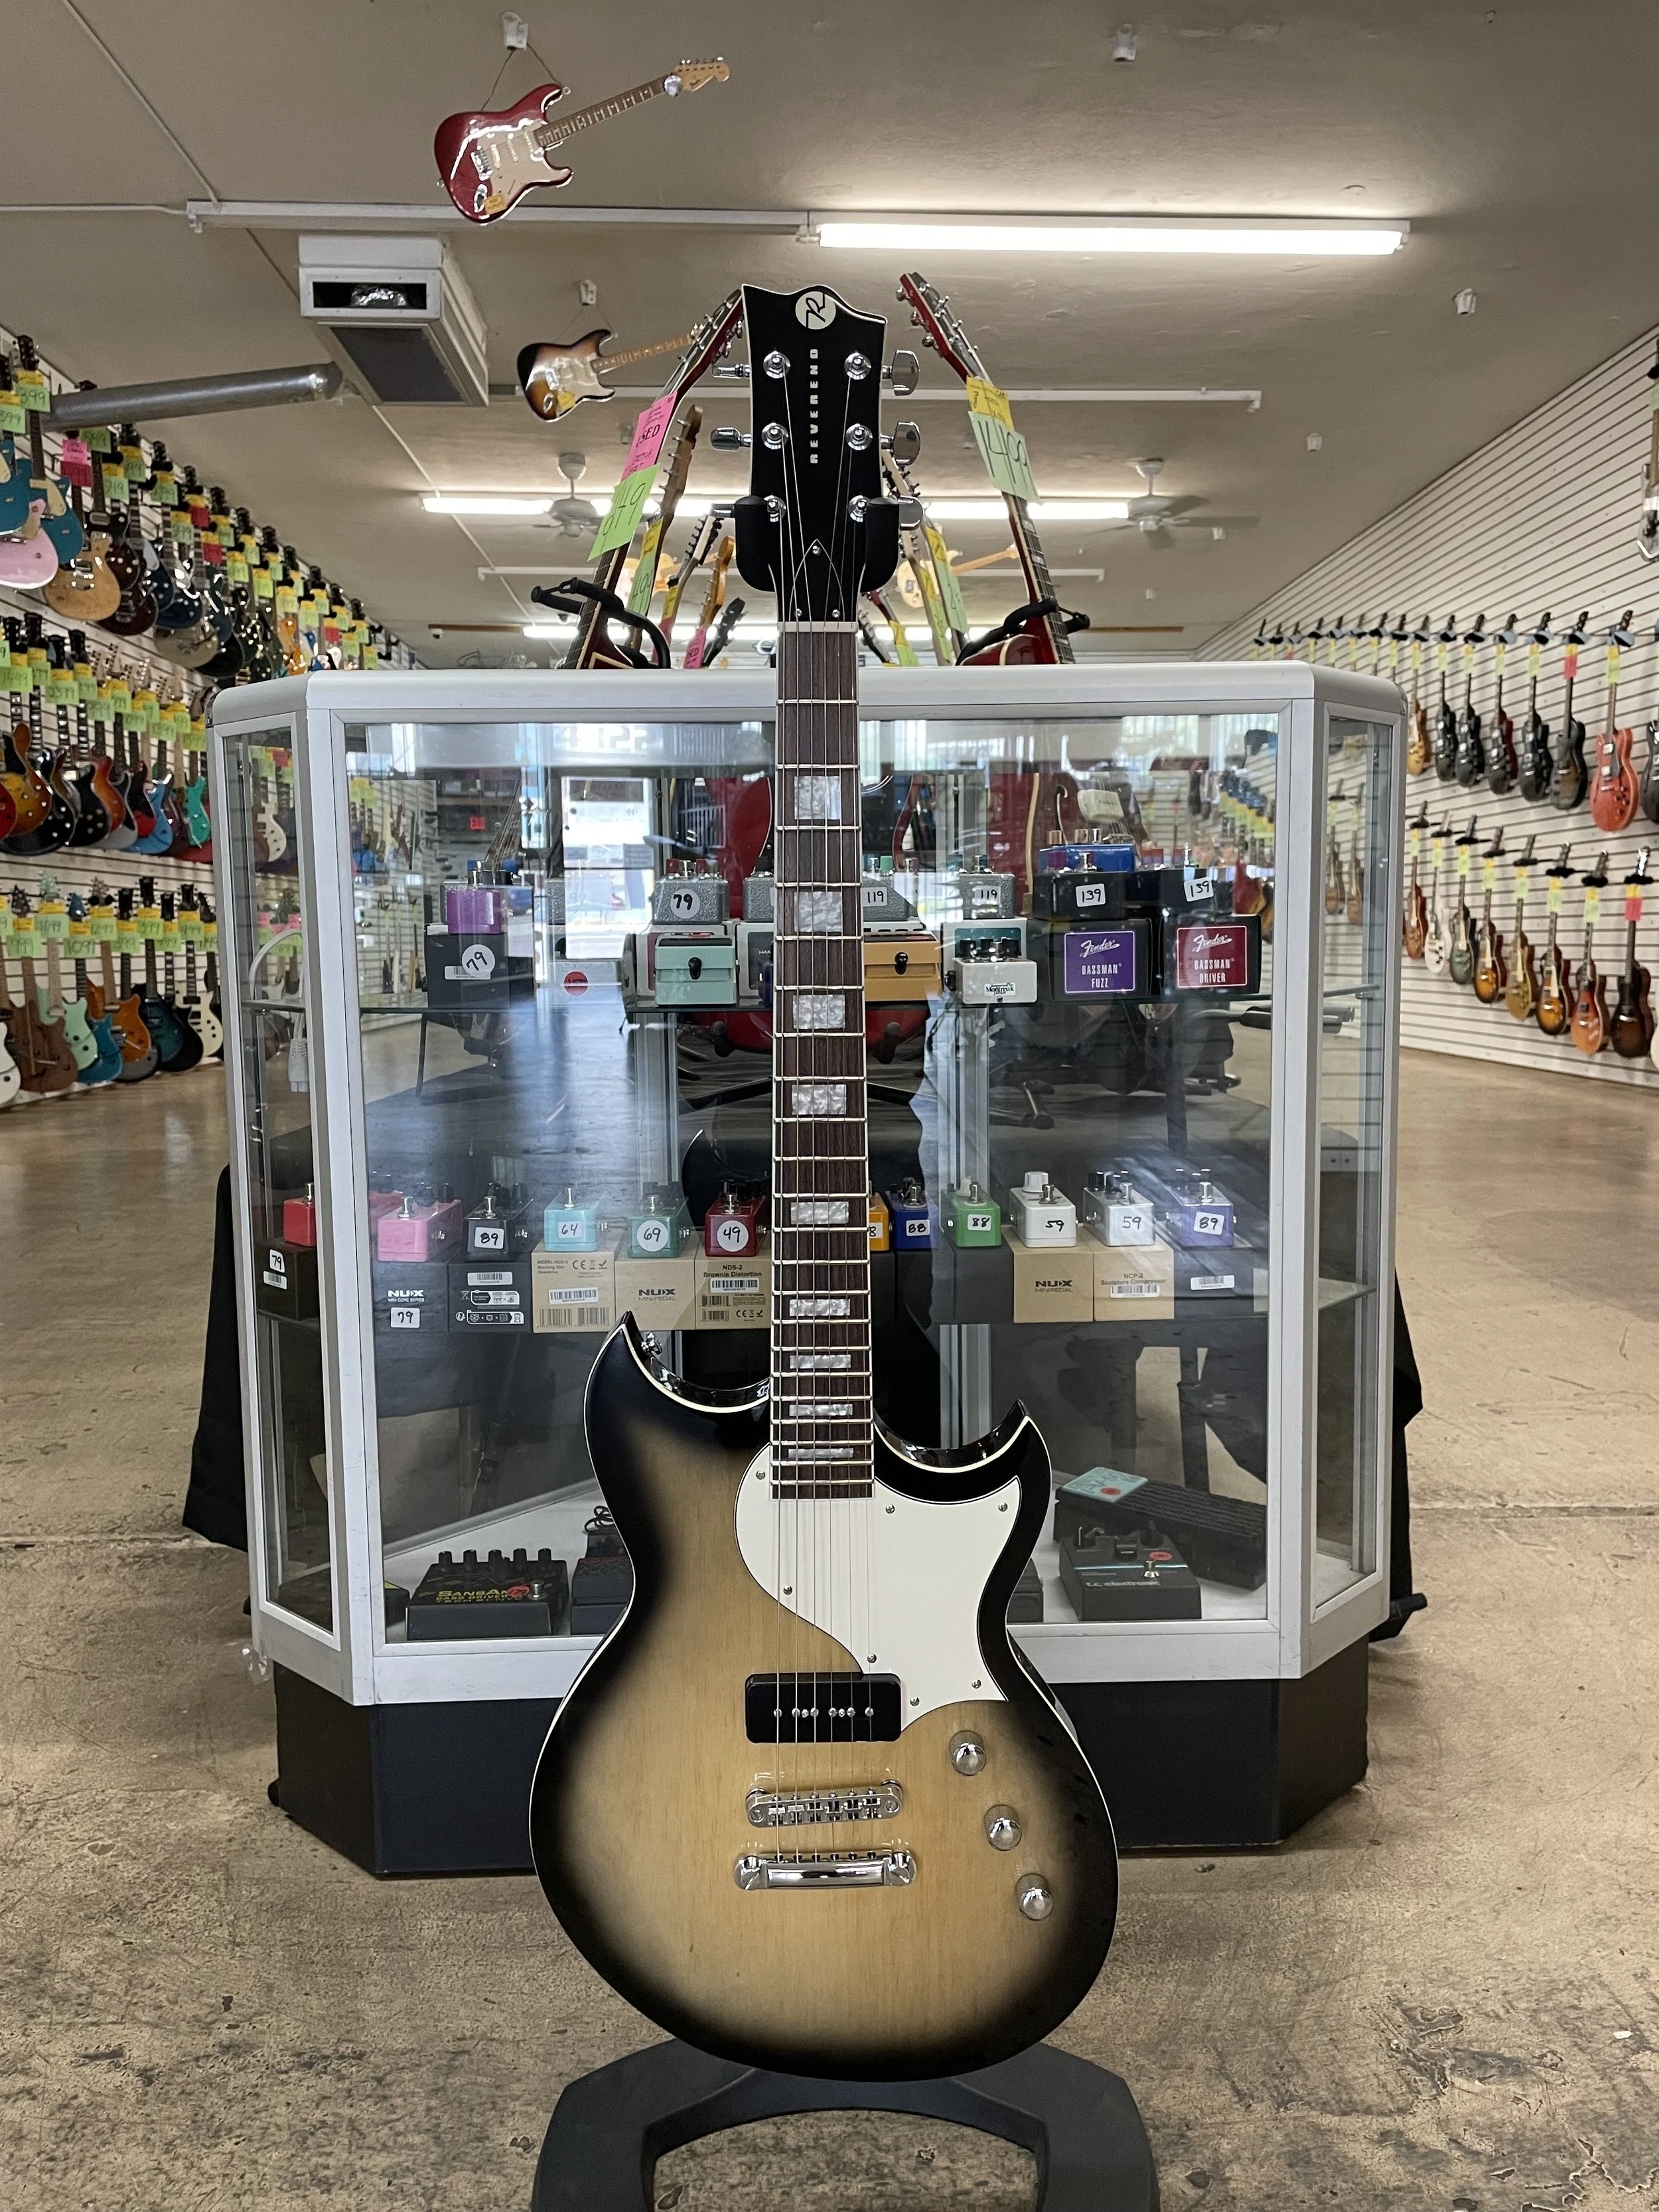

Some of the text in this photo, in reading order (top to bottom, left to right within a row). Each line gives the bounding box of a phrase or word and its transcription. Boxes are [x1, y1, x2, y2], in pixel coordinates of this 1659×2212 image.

[810, 348, 819, 464] REVEREND
[981, 889, 997, 900] 119
[1082, 888, 1101, 903] 139
[1190, 881, 1209, 897] 139
[673, 893, 693, 911] 79
[867, 890, 884, 903] 119
[1079, 938, 1119, 958] Fender
[1192, 934, 1232, 952] Fender
[466, 951, 488, 971] 79
[1194, 959, 1230, 970] BASSMAN
[1082, 964, 1118, 975] BASSMAN
[1092, 978, 1108, 988] FUZZ
[1199, 972, 1226, 983] DRIVER
[561, 1223, 578, 1235] 64
[1045, 1220, 1064, 1232] 59
[1122, 1216, 1141, 1230] 59
[1199, 1217, 1218, 1230] 89
[480, 1232, 498, 1246] 89
[644, 1227, 661, 1242] 69
[723, 1226, 741, 1243] 49
[271, 1255, 282, 1270] 79
[397, 1311, 413, 1323] 79
